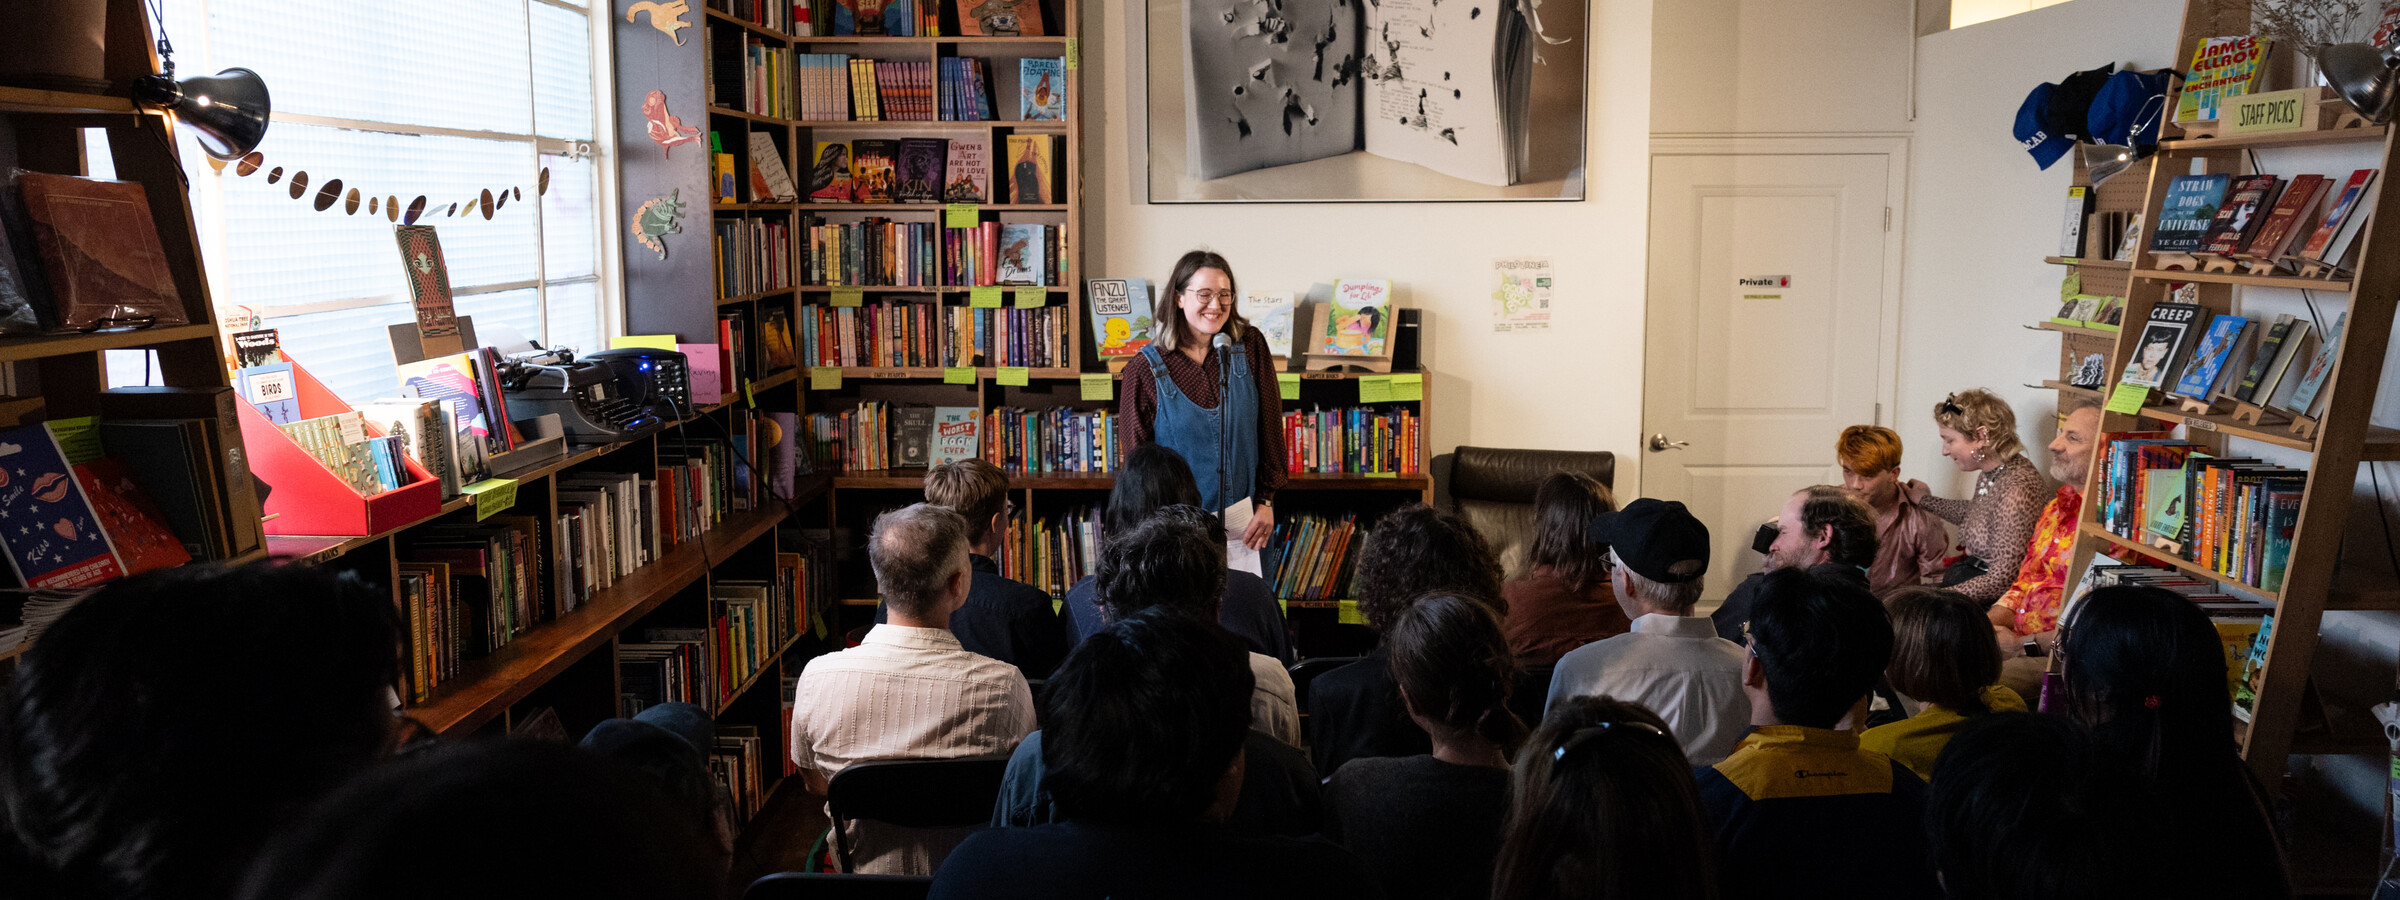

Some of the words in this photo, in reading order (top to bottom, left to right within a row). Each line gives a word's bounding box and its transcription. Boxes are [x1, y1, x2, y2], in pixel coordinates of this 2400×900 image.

[2198, 36, 2257, 59] JAMES
[2194, 48, 2260, 73] ELLROY
[2185, 72, 2252, 93] ENCHANTERS
[2239, 103, 2264, 127] STAFF
[2265, 99, 2297, 125] PICKS
[950, 142, 975, 151] GWEN
[958, 150, 977, 160] ART
[902, 180, 932, 191] KIN
[2179, 179, 2214, 192] STRAW
[2236, 180, 2247, 189] MY
[2178, 195, 2205, 207] DOGS
[2217, 210, 2234, 219] SCAR
[2158, 219, 2211, 231] UNIVERSE
[2218, 232, 2242, 241] NICOLAS
[1739, 278, 1773, 286] Private
[1094, 282, 1126, 297] ANZU
[1343, 283, 1384, 296] Dumplings
[1248, 296, 1262, 304] The
[1263, 295, 1282, 304] Stars
[1350, 292, 1360, 300] for
[1097, 303, 1129, 313] LISTENER
[2150, 307, 2194, 322] CREEP
[238, 337, 275, 349] Woods
[261, 382, 282, 396] BIRDS
[943, 423, 971, 435] WORST
[940, 436, 972, 446] BOOK
[2, 485, 25, 507] Smile
[2205, 513, 2213, 545] FRENCH
[27, 538, 50, 566] Kiss
[46, 568, 80, 585] RECOMMENDED
[89, 558, 111, 570] CHILDREN
[73, 575, 87, 584] YEARS
[1794, 770, 1849, 780] Champion
